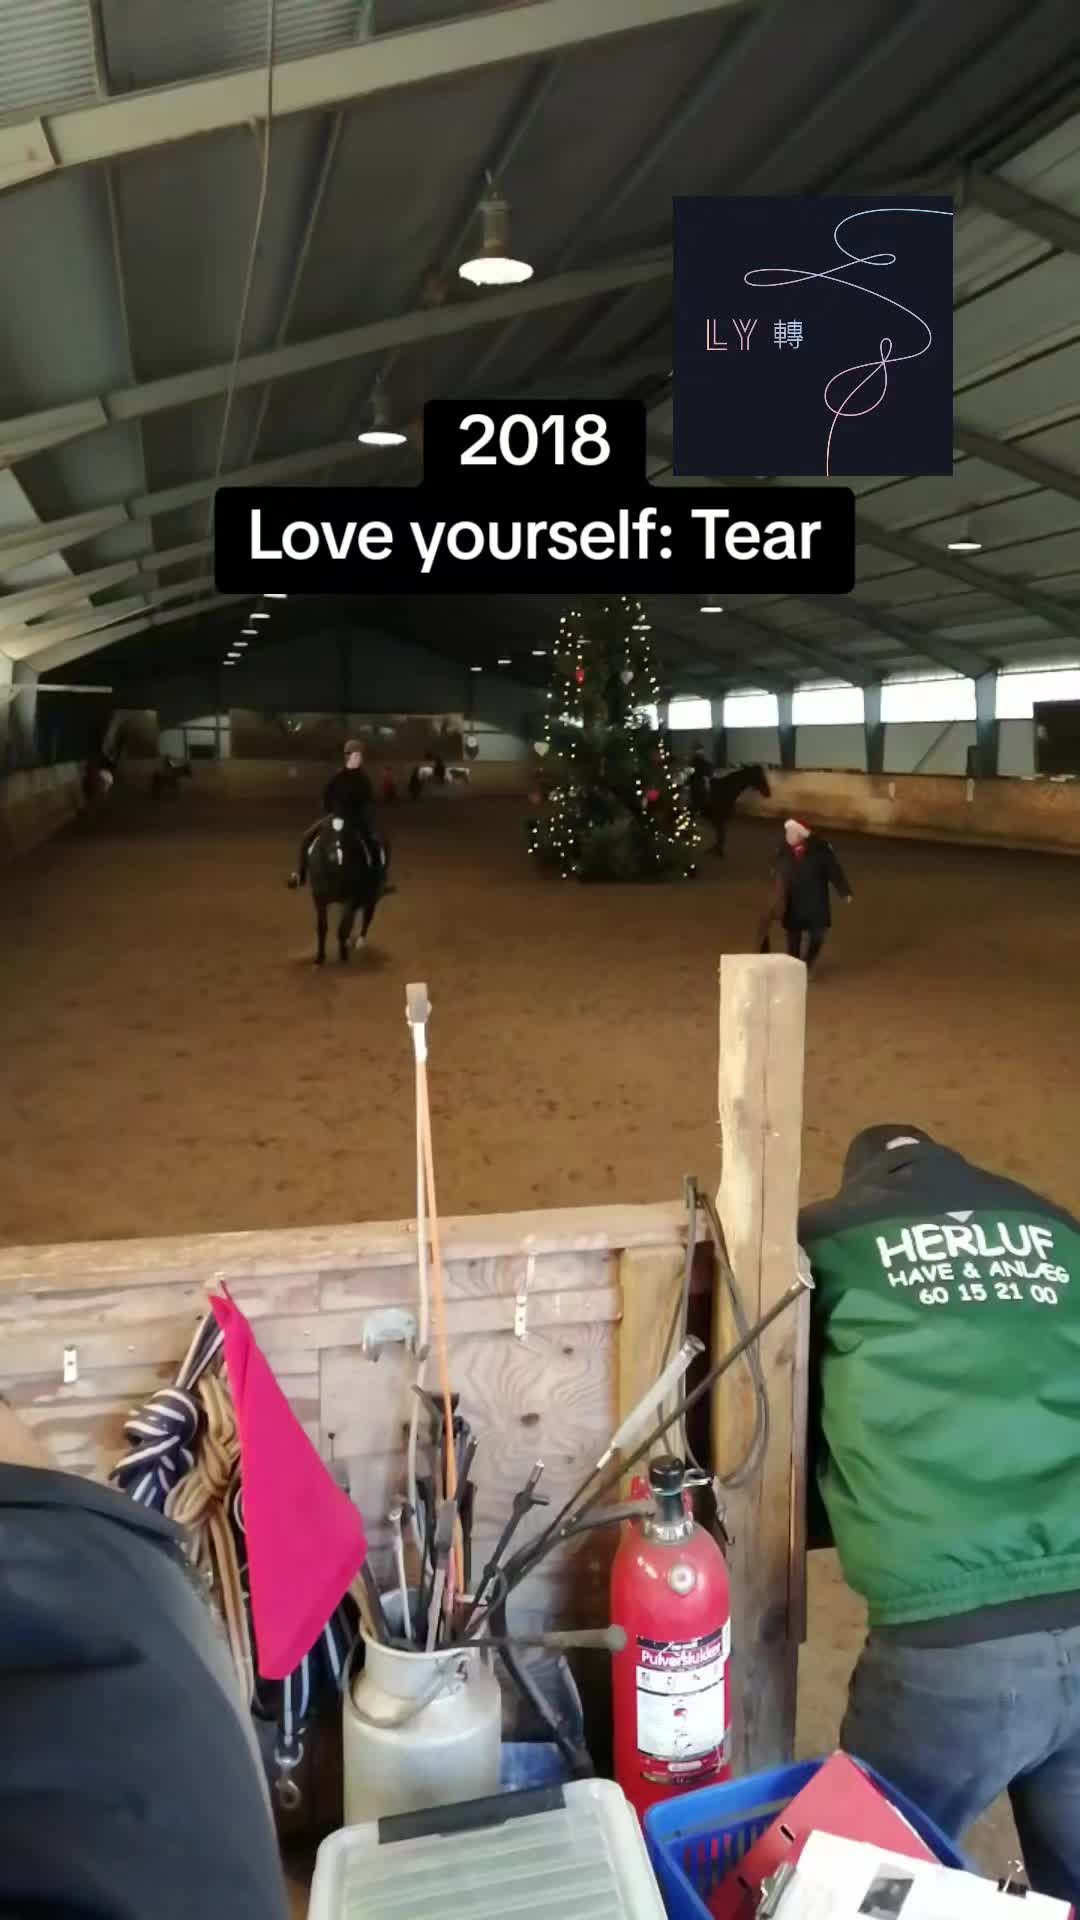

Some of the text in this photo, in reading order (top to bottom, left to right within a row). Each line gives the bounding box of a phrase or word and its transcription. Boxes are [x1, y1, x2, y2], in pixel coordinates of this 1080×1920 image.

[876, 1222, 1054, 1268] HERLUF
[888, 1260, 1070, 1288] HAVE & ANLÆG
[919, 1282, 1058, 1305] 60 15 21 00
